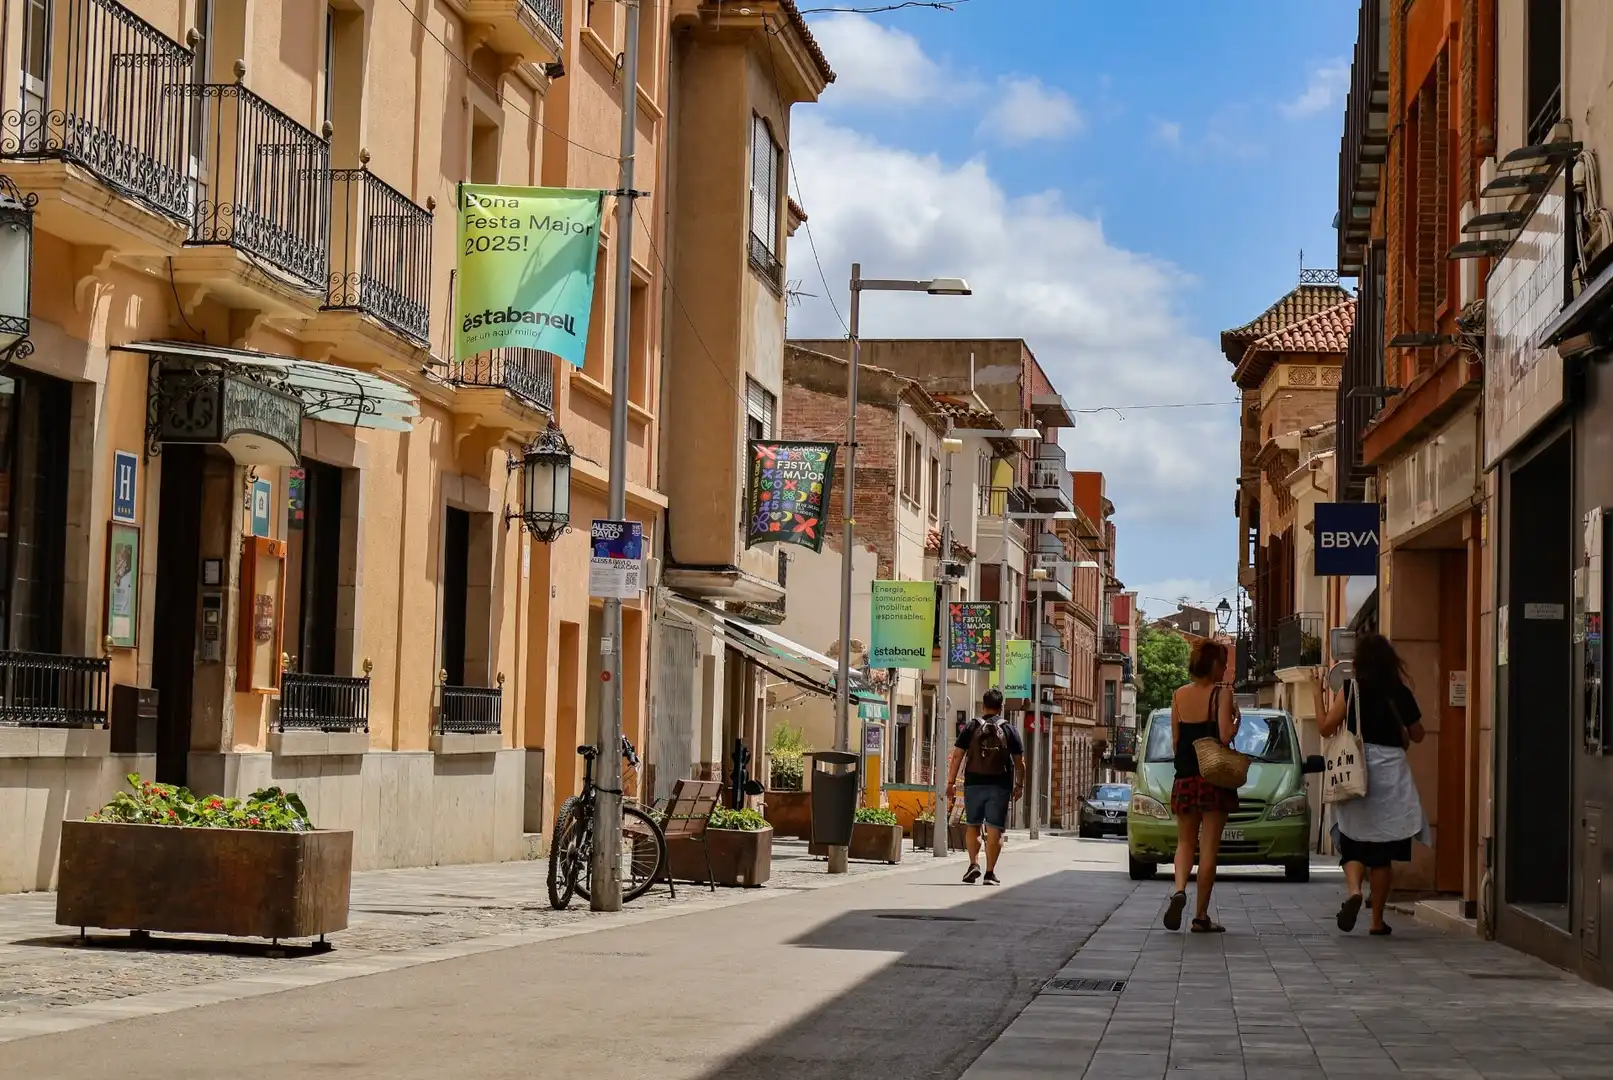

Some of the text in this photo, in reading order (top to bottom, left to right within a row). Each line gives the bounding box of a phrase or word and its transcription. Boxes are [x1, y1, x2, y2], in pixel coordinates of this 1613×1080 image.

[465, 193, 519, 209] Bona
[465, 214, 593, 237] Festa Major
[465, 235, 528, 256] 2025!
[479, 332, 491, 340] un
[119, 464, 132, 501] H
[783, 470, 824, 483] MAJOR
[592, 523, 617, 532] ALESS
[617, 524, 624, 533] &
[592, 529, 620, 539] BAYLO
[1320, 529, 1380, 548] BBVA
